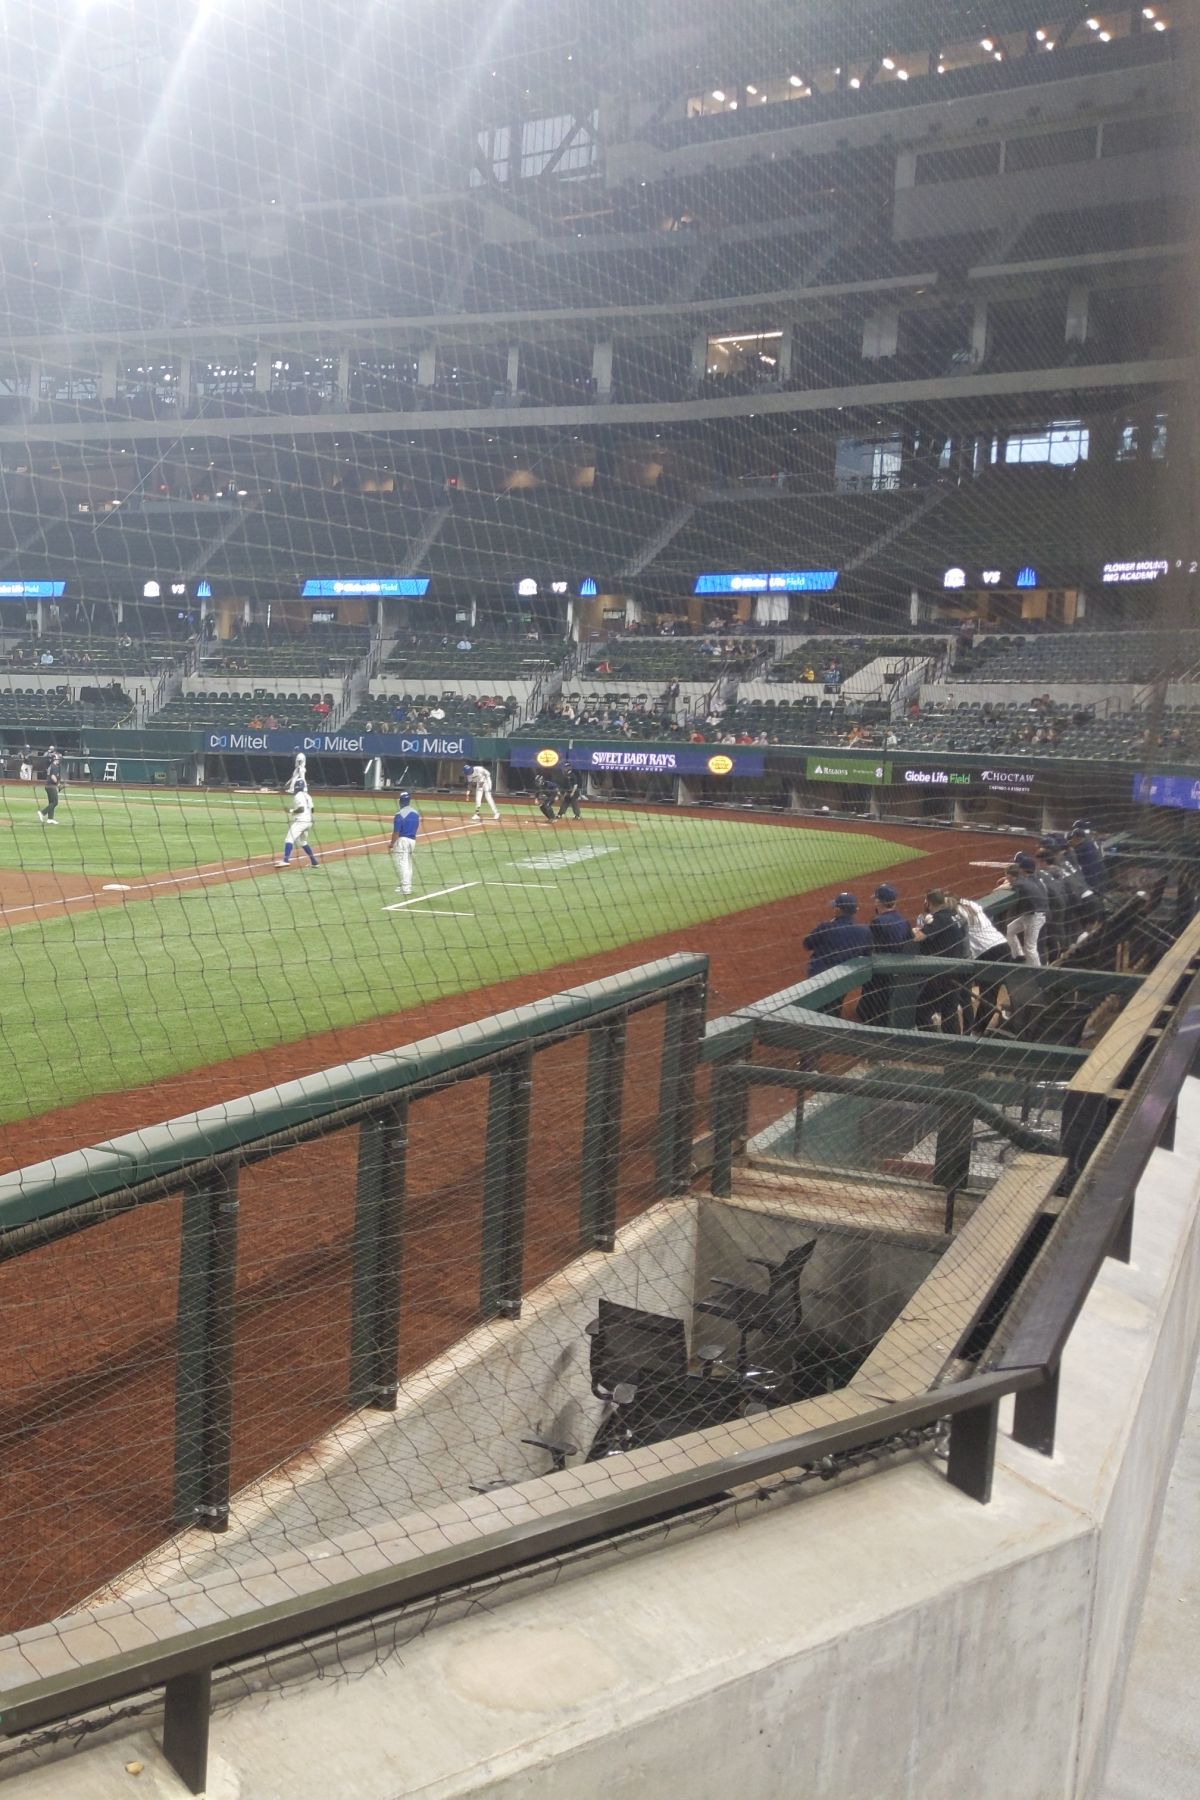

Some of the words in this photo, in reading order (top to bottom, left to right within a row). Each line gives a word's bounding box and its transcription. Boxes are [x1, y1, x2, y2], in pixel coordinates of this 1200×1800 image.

[983, 571, 1001, 584] VS
[552, 581, 568, 593] VS
[230, 734, 268, 749] Mitel
[325, 736, 364, 751] Mitel
[422, 738, 464, 754] Mitel
[592, 752, 623, 765] SWEET
[624, 753, 648, 765] BABY
[904, 770, 931, 782] Globe
[931, 771, 949, 784] Life
[949, 773, 971, 785] Field
[986, 770, 1035, 783] CHOCTAW
